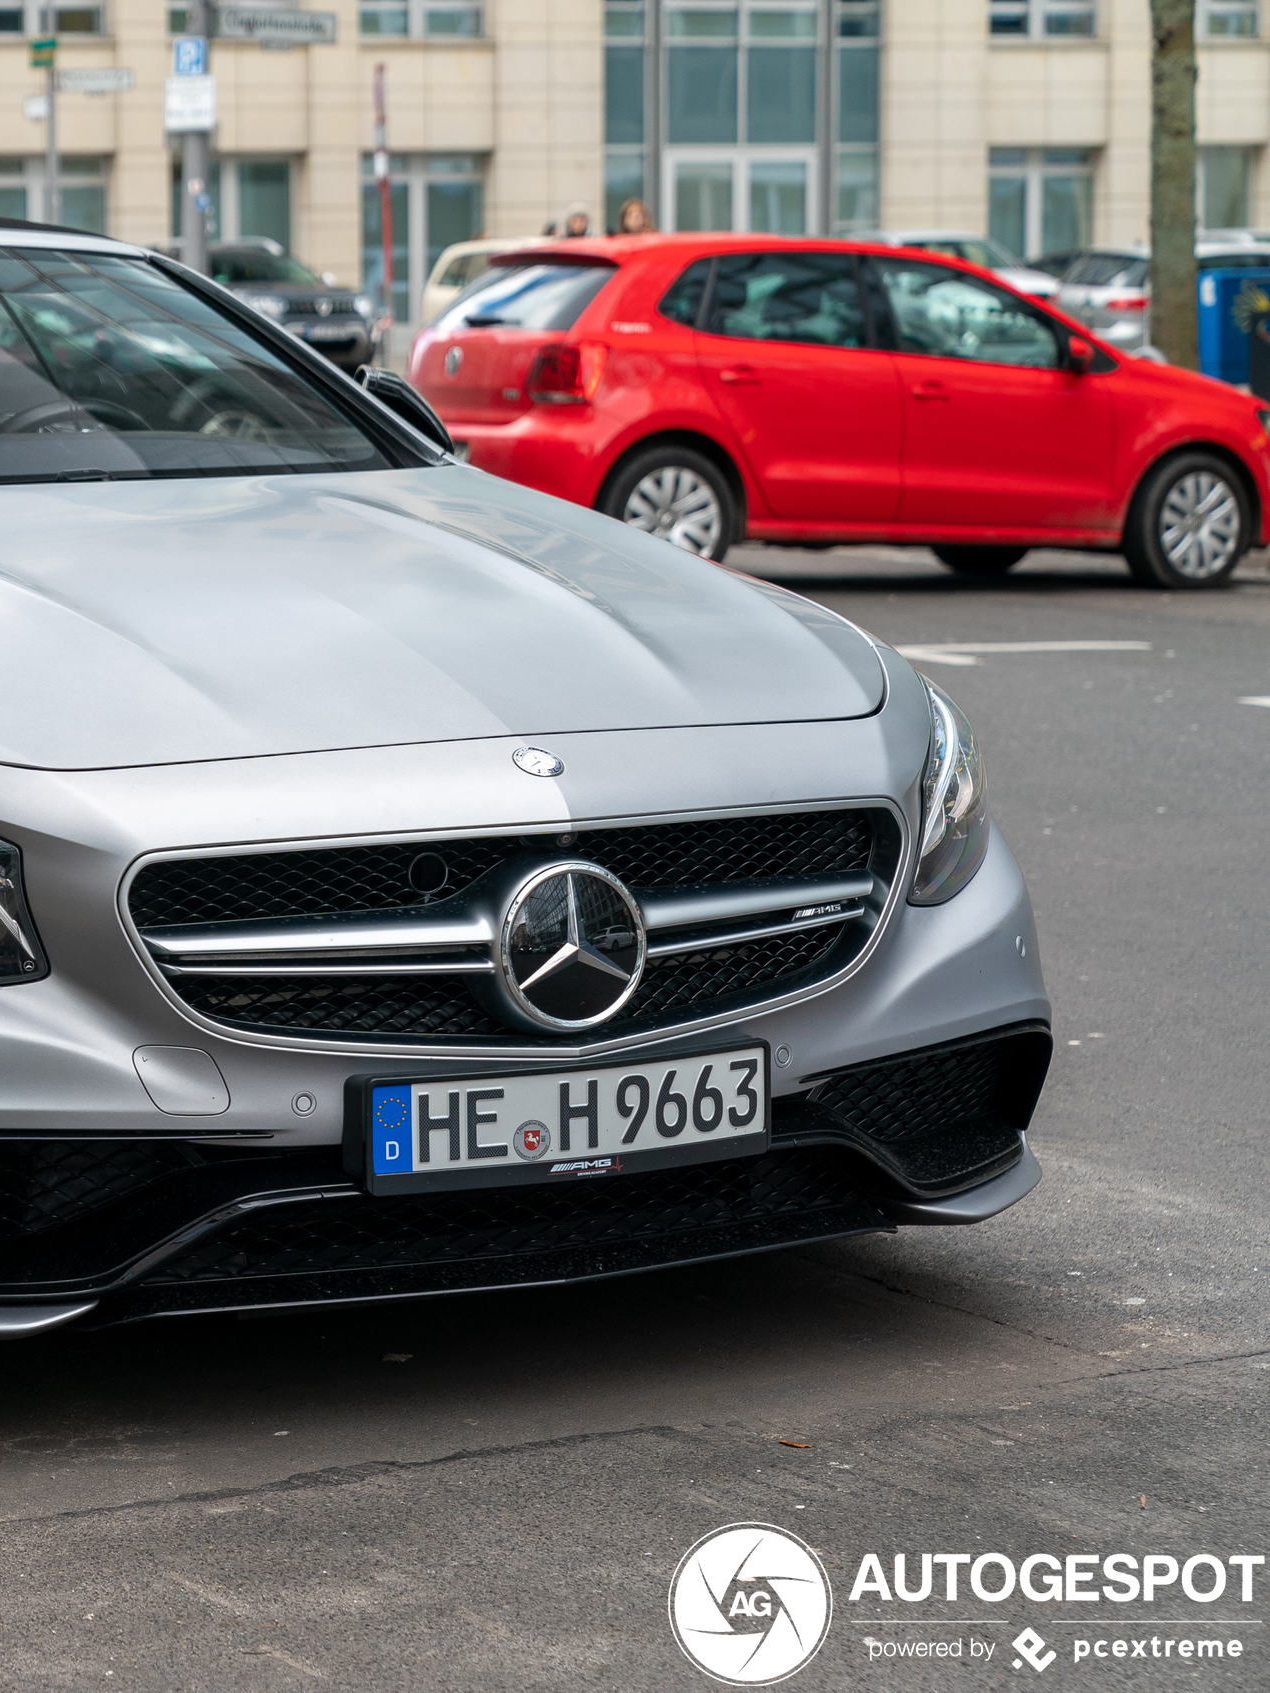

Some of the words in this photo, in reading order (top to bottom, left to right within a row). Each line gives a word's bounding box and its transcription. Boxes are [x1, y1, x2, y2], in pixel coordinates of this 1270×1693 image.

[416, 1088, 509, 1164] HE
[558, 1079, 599, 1151] H
[614, 1058, 759, 1145] 9663
[385, 1140, 400, 1160] D
[571, 1158, 612, 1170] AMG
